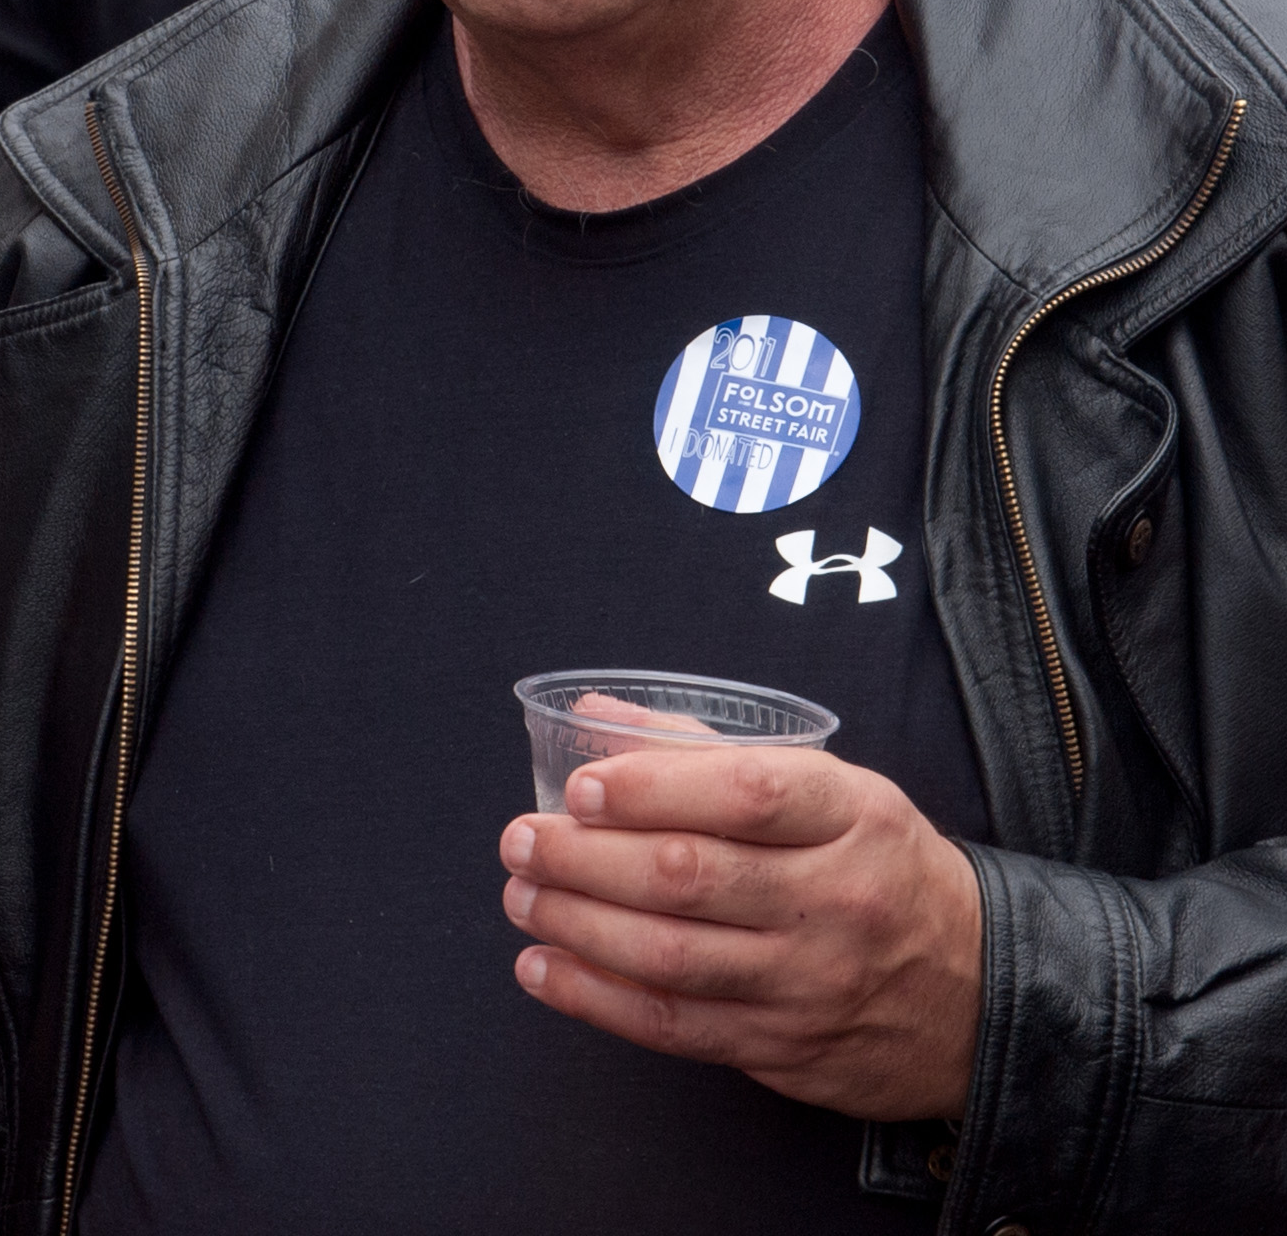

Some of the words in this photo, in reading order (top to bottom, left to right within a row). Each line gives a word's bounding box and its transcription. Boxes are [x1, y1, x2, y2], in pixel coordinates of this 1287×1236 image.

[710, 327, 777, 378] 2011
[717, 407, 787, 434] STREET
[787, 423, 828, 444] FAIR
[682, 429, 774, 470] DONATED
